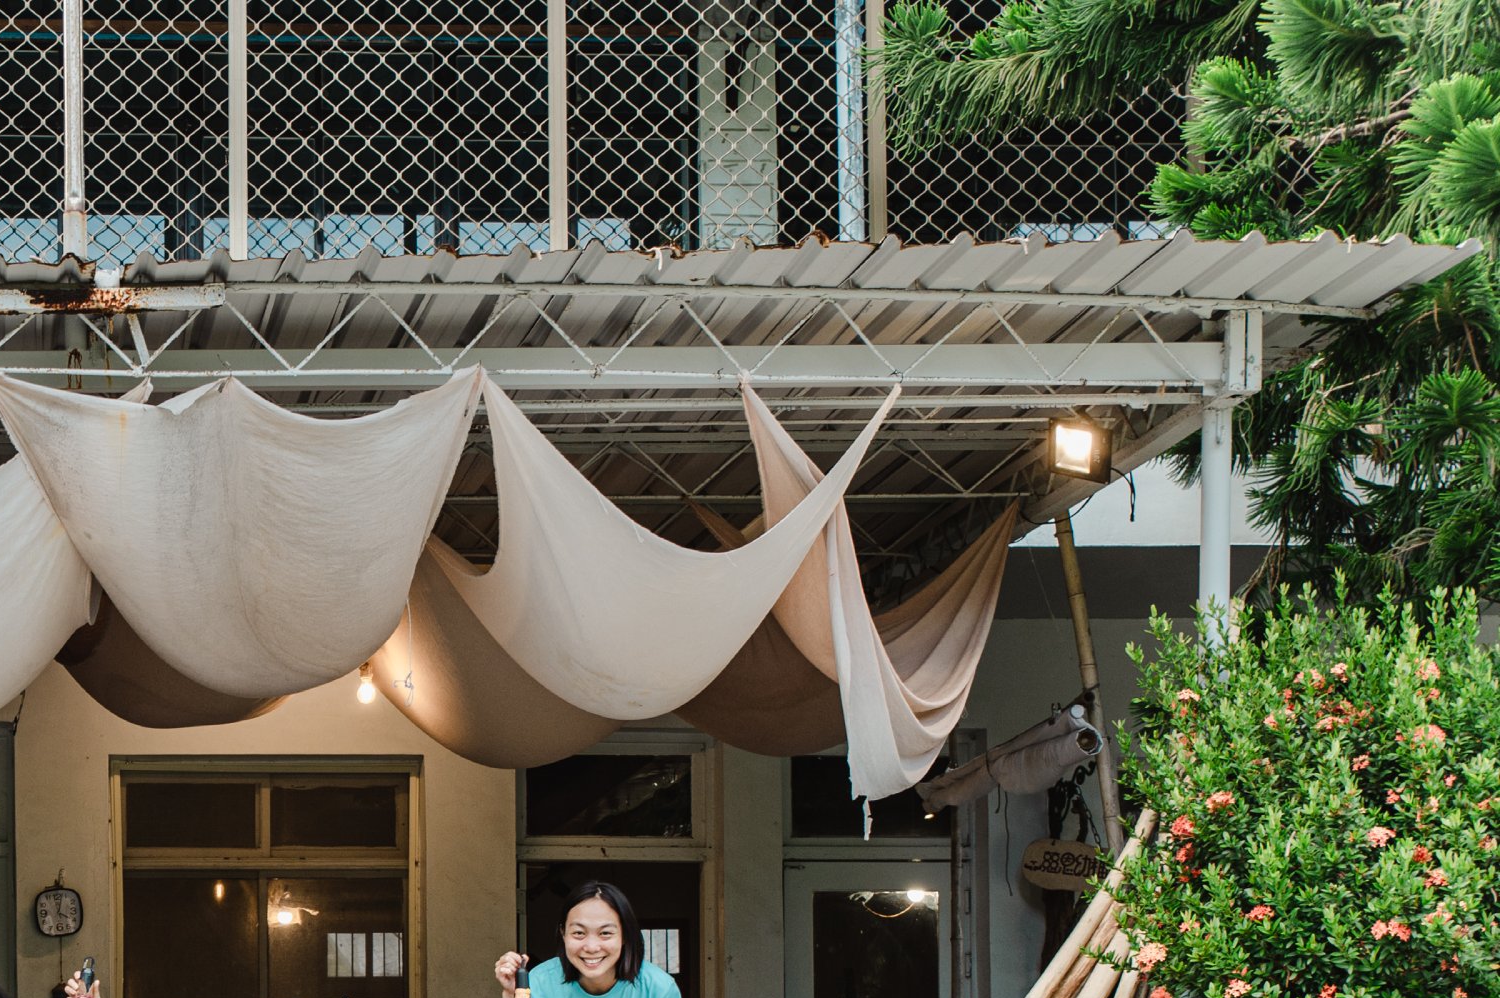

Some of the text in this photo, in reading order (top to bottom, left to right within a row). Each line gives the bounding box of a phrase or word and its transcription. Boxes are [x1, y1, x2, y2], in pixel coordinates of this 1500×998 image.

[40, 908, 47, 918] 9
[70, 906, 77, 915] 3
[56, 922, 64, 932] 6
